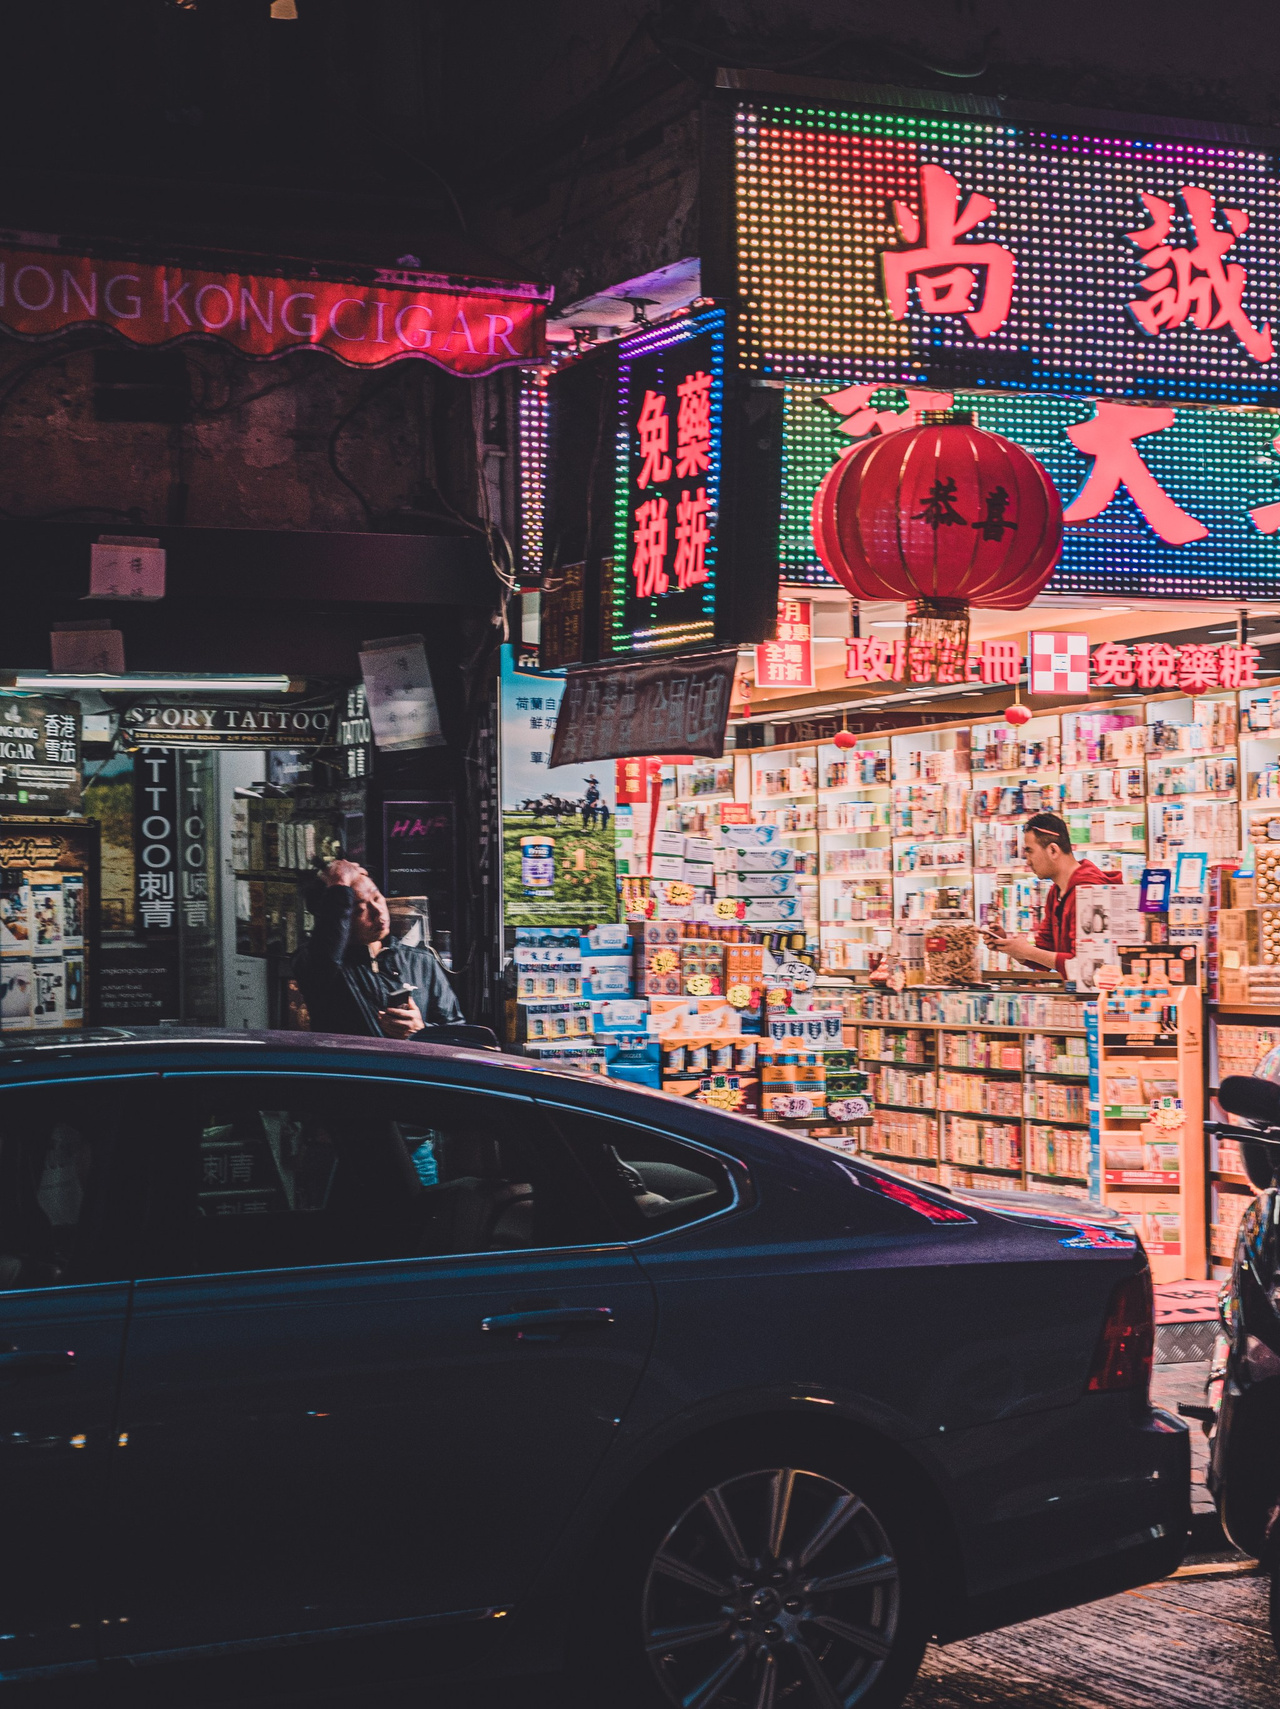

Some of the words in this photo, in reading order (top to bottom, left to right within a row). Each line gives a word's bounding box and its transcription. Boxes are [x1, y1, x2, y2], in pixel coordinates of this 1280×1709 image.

[0, 262, 142, 320] ONG
[162, 279, 318, 337] KONG
[328, 298, 523, 357] CIGAR
[764, 643, 803, 663] 全場
[766, 662, 804, 681] 打折
[515, 696, 561, 711] 荷蘭自
[44, 714, 77, 739] 香港
[131, 706, 218, 728] STORY
[223, 710, 329, 731] TATTOO
[150, 733, 196, 741] LOCKHART
[197, 734, 221, 742] ROAD
[44, 738, 77, 763] 雪茄
[138, 870, 176, 929] 刺青
